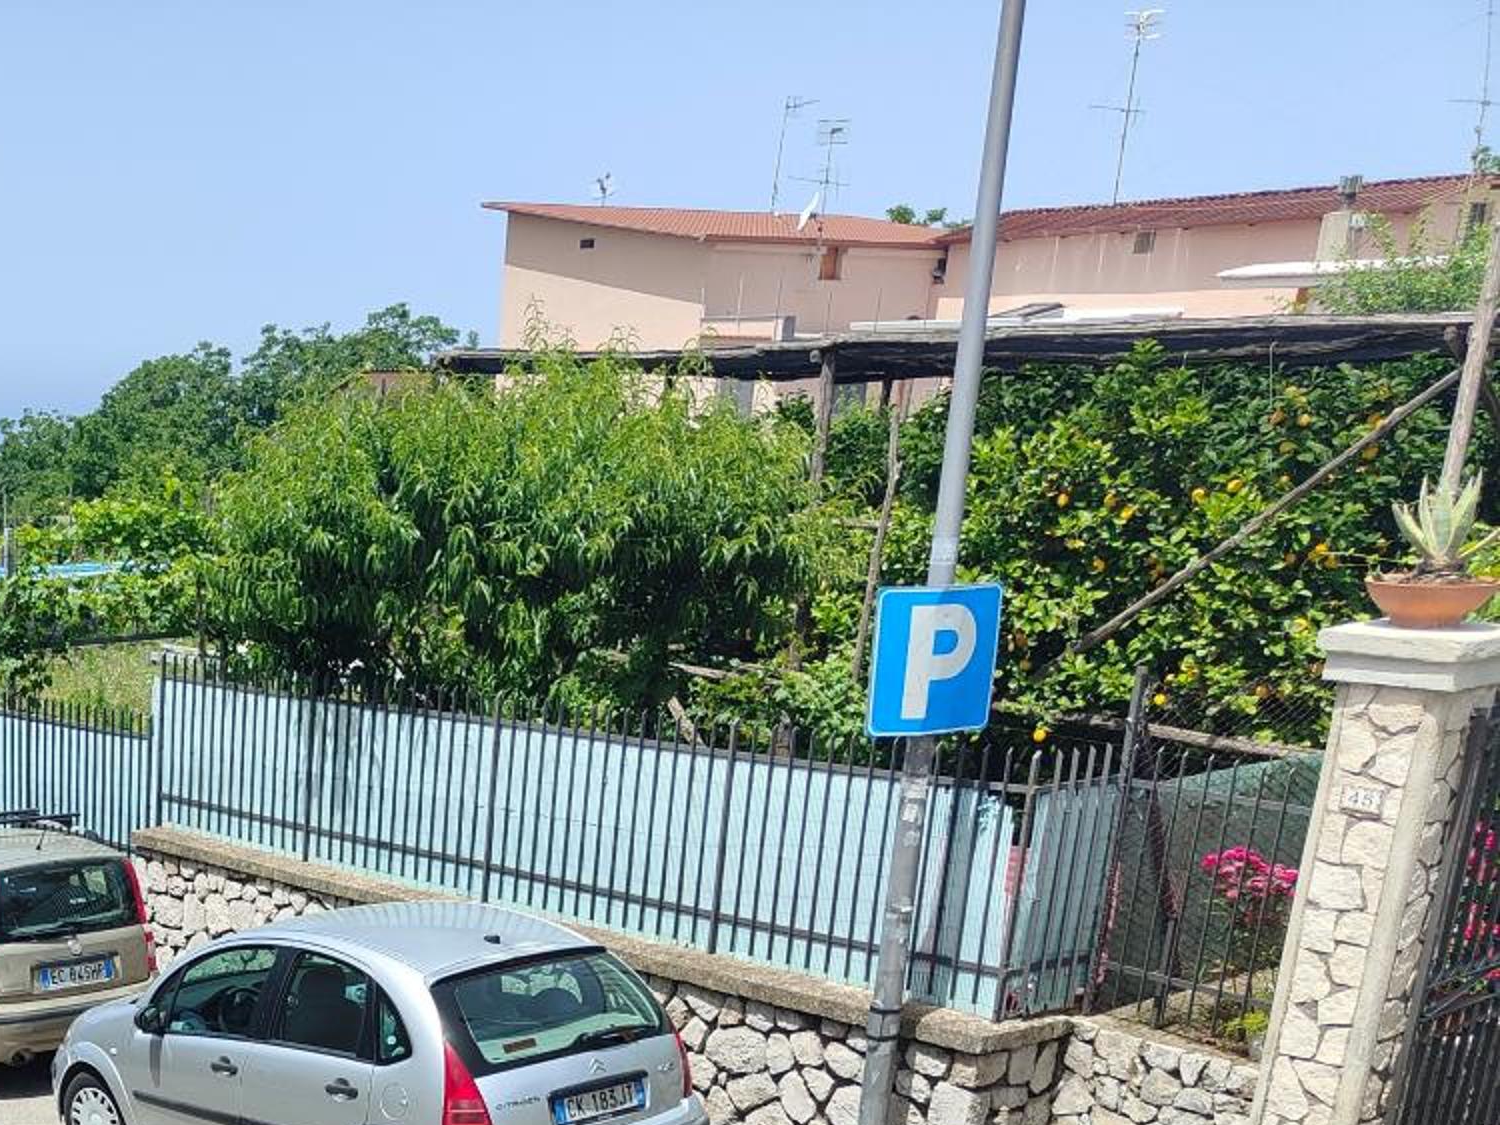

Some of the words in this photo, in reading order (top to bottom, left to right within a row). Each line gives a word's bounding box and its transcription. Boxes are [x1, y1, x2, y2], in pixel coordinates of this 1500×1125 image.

[900, 604, 977, 720] P
[567, 1097, 586, 1118] CK
[591, 1085, 633, 1112] 183JT
